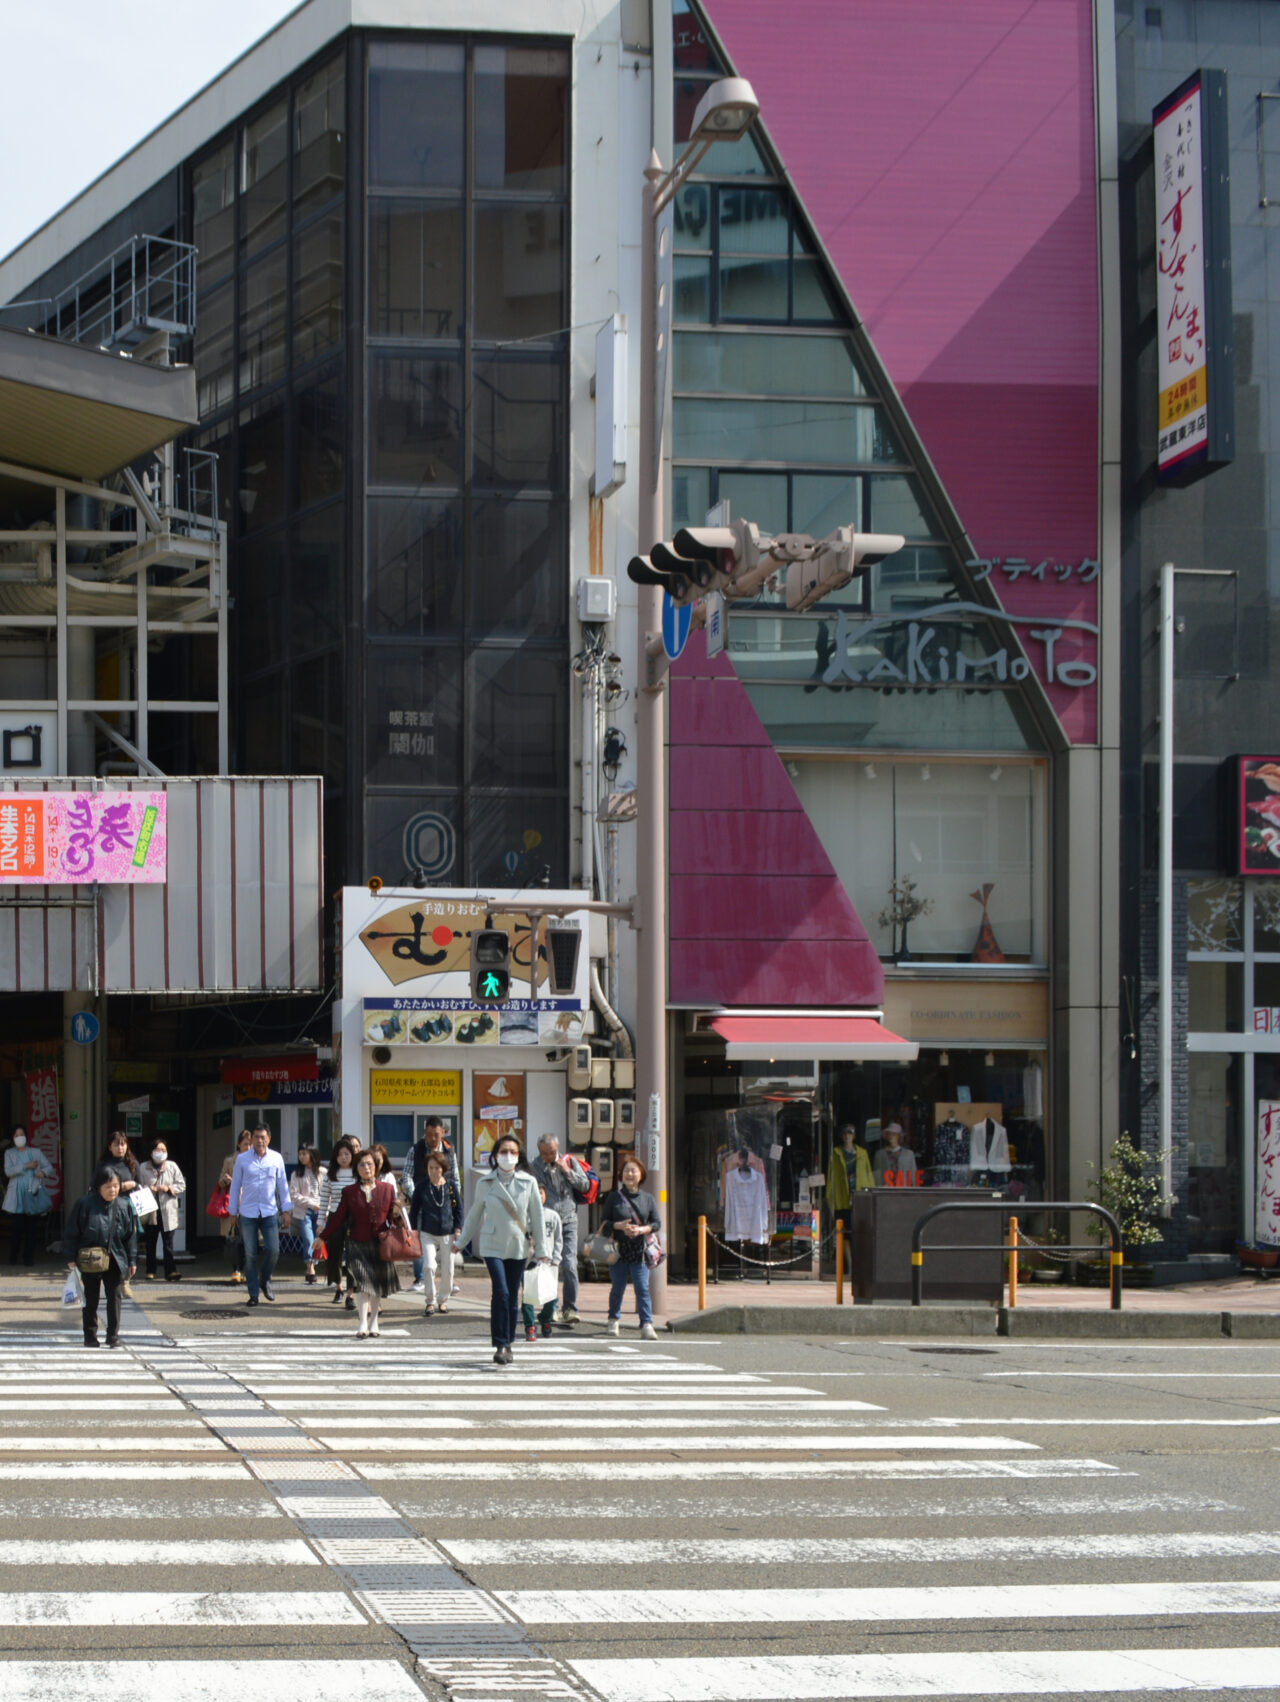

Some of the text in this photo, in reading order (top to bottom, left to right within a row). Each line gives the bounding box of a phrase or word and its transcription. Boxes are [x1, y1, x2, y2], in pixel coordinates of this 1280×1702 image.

[966, 556, 1100, 583] ブティック
[0, 806, 18, 871] 生本マグロ
[883, 1170, 925, 1187] SALE
